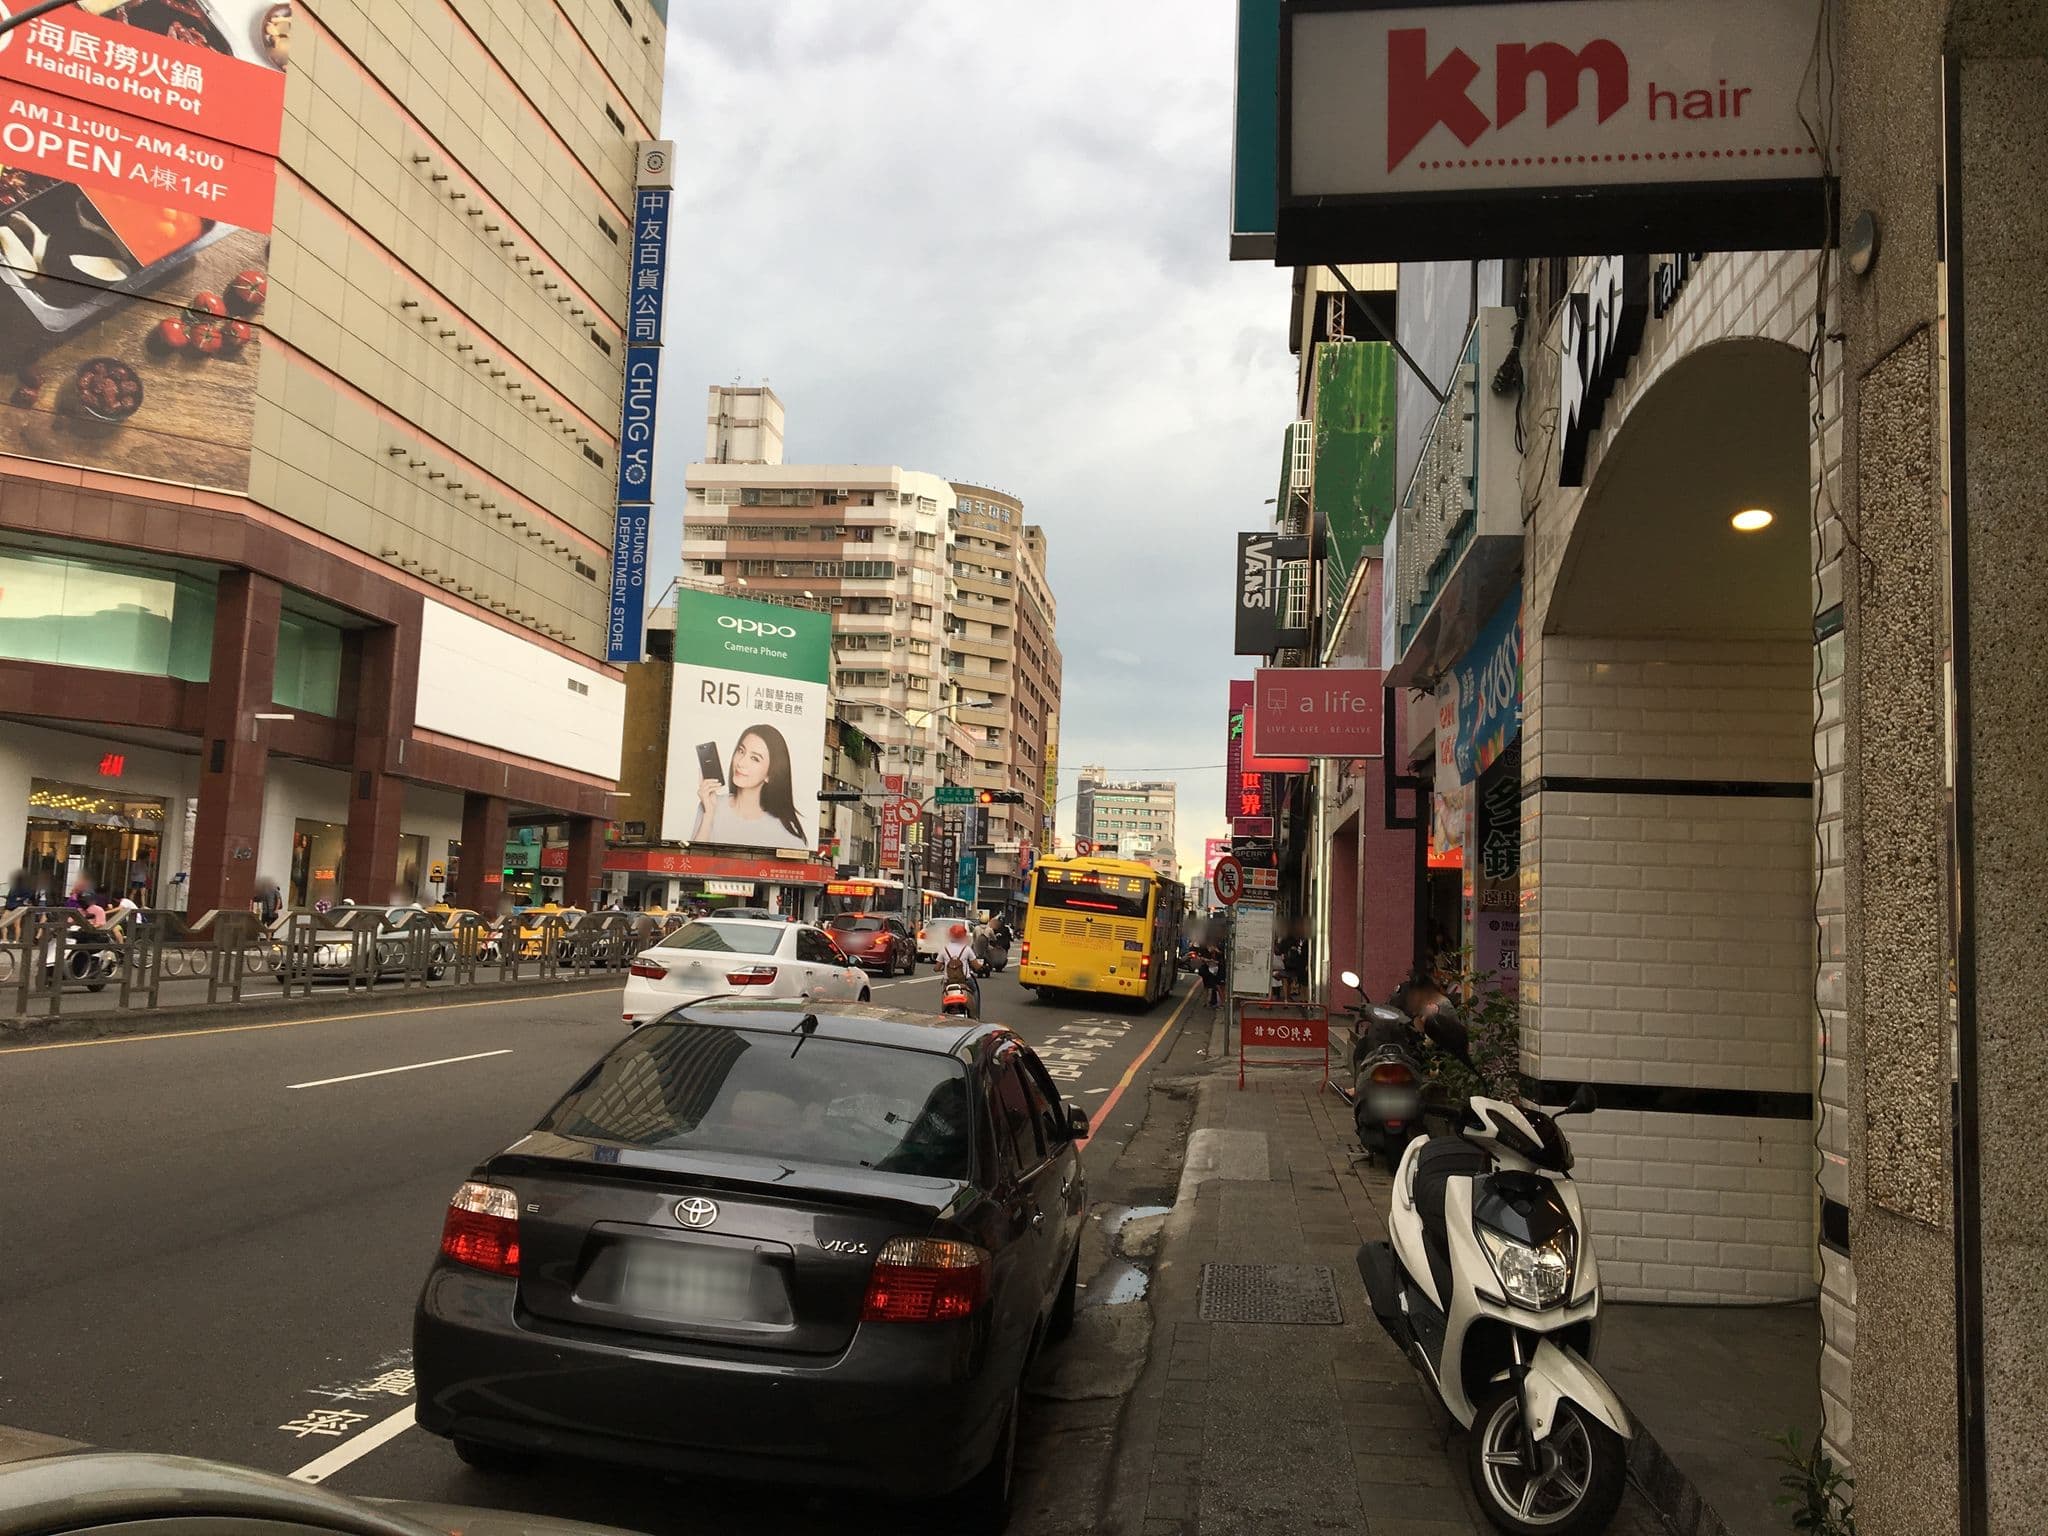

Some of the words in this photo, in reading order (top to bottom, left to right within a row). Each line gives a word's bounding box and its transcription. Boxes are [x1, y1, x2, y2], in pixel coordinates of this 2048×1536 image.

[27, 18, 204, 94] 海底撈火鍋
[25, 49, 120, 90] Haidilao
[123, 76, 161, 105] Hot
[166, 89, 202, 116] Pot
[1387, 28, 1630, 175] km
[1648, 79, 1752, 121] hair
[3, 123, 121, 178] OPEN
[635, 192, 664, 341] 中友百貨公司
[628, 362, 653, 442] CHUNG
[625, 448, 648, 486] YO
[614, 516, 631, 604] DEPARTMENT
[632, 517, 646, 563] CHUNG
[631, 568, 642, 587] YO
[1243, 541, 1273, 609] VANS
[611, 607, 625, 652] STORE
[724, 640, 758, 656] Camera
[760, 646, 788, 660] Phone
[701, 679, 741, 707] R15
[754, 699, 803, 716] 讓美更自然
[1299, 694, 1314, 713] a
[1324, 690, 1374, 713] life.
[816, 1237, 869, 1255] VIOS
